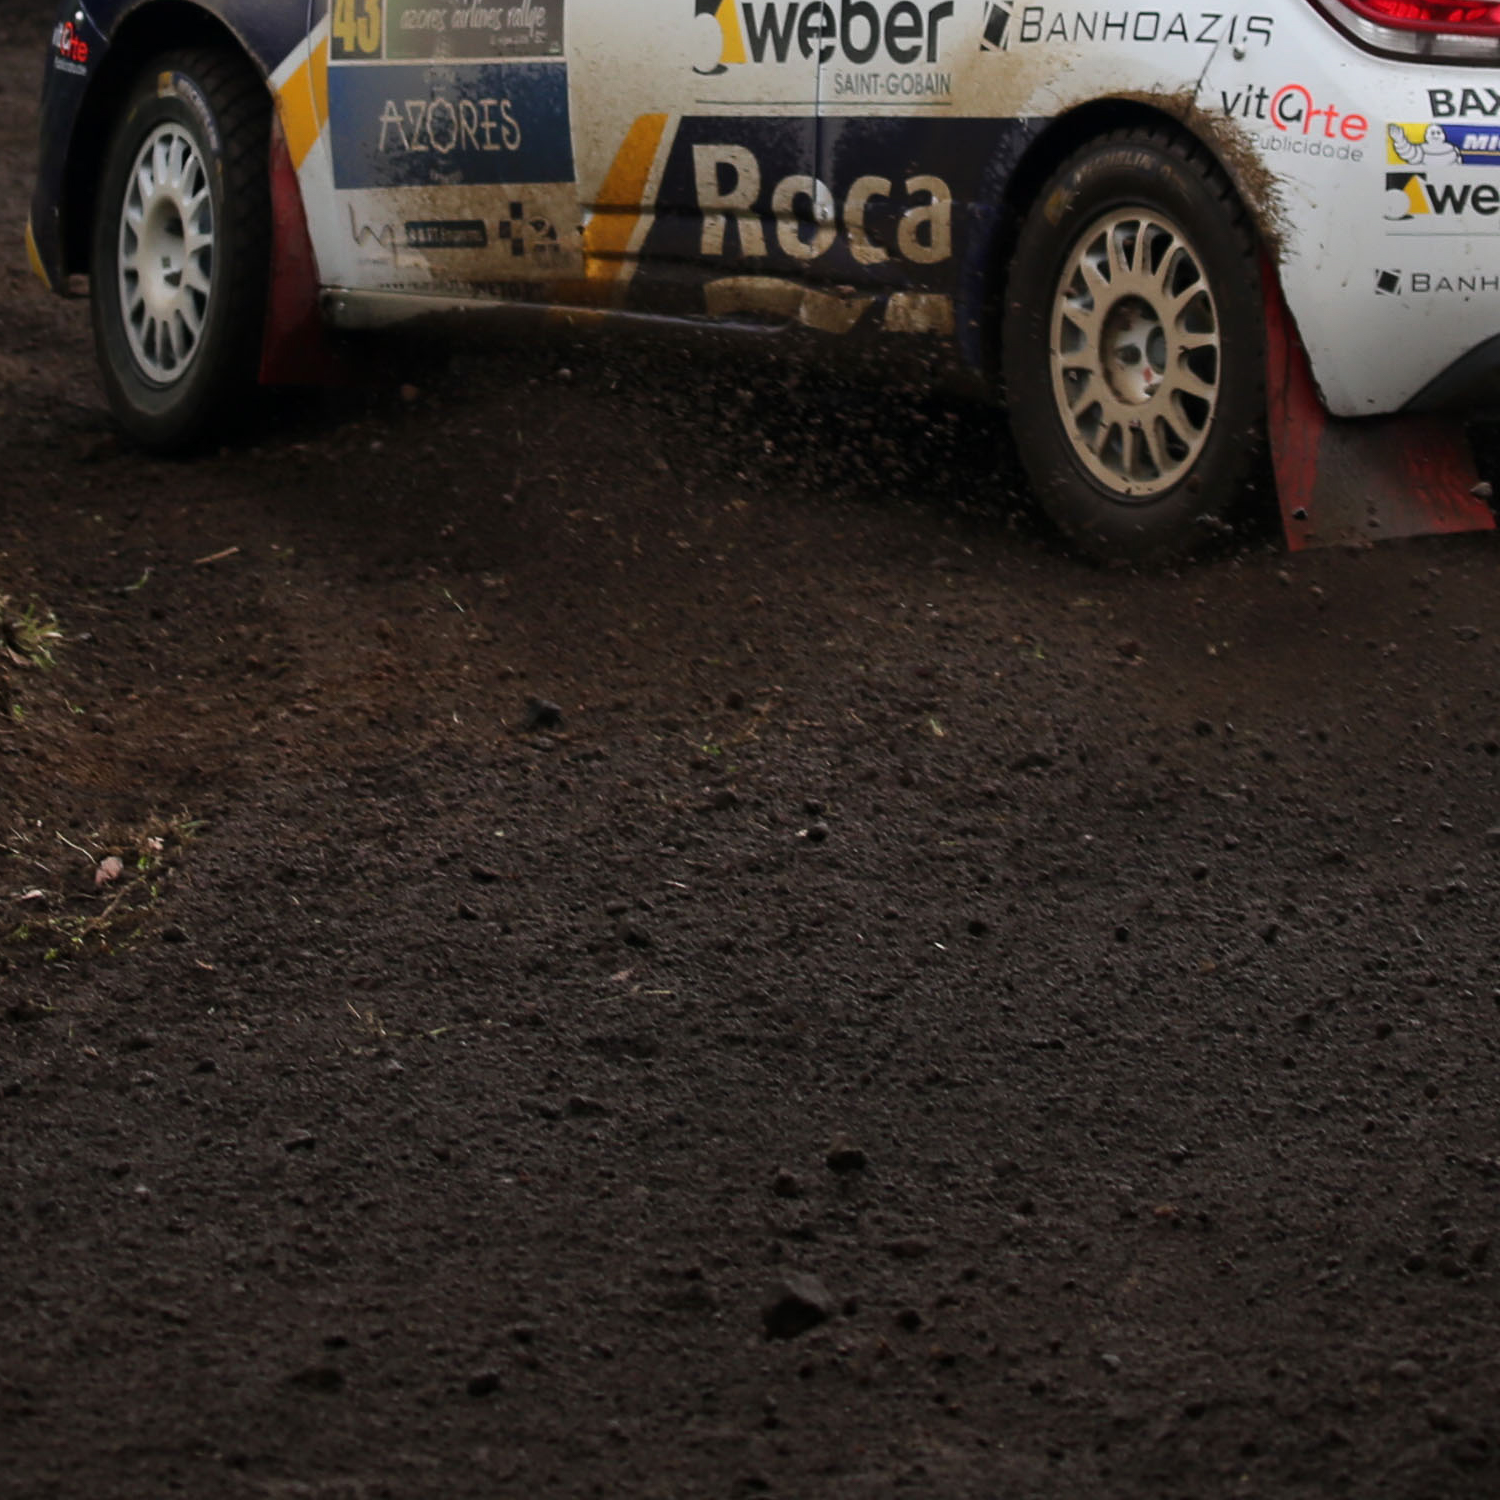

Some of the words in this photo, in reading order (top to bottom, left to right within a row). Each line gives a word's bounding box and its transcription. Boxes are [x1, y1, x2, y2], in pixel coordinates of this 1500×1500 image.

[401, 6, 449, 33] azores
[833, 72, 952, 97] SAINT-GOBAIN
[378, 97, 522, 154] AZORES
[1250, 131, 1365, 163] Publicidade
[692, 143, 954, 265] Roca
